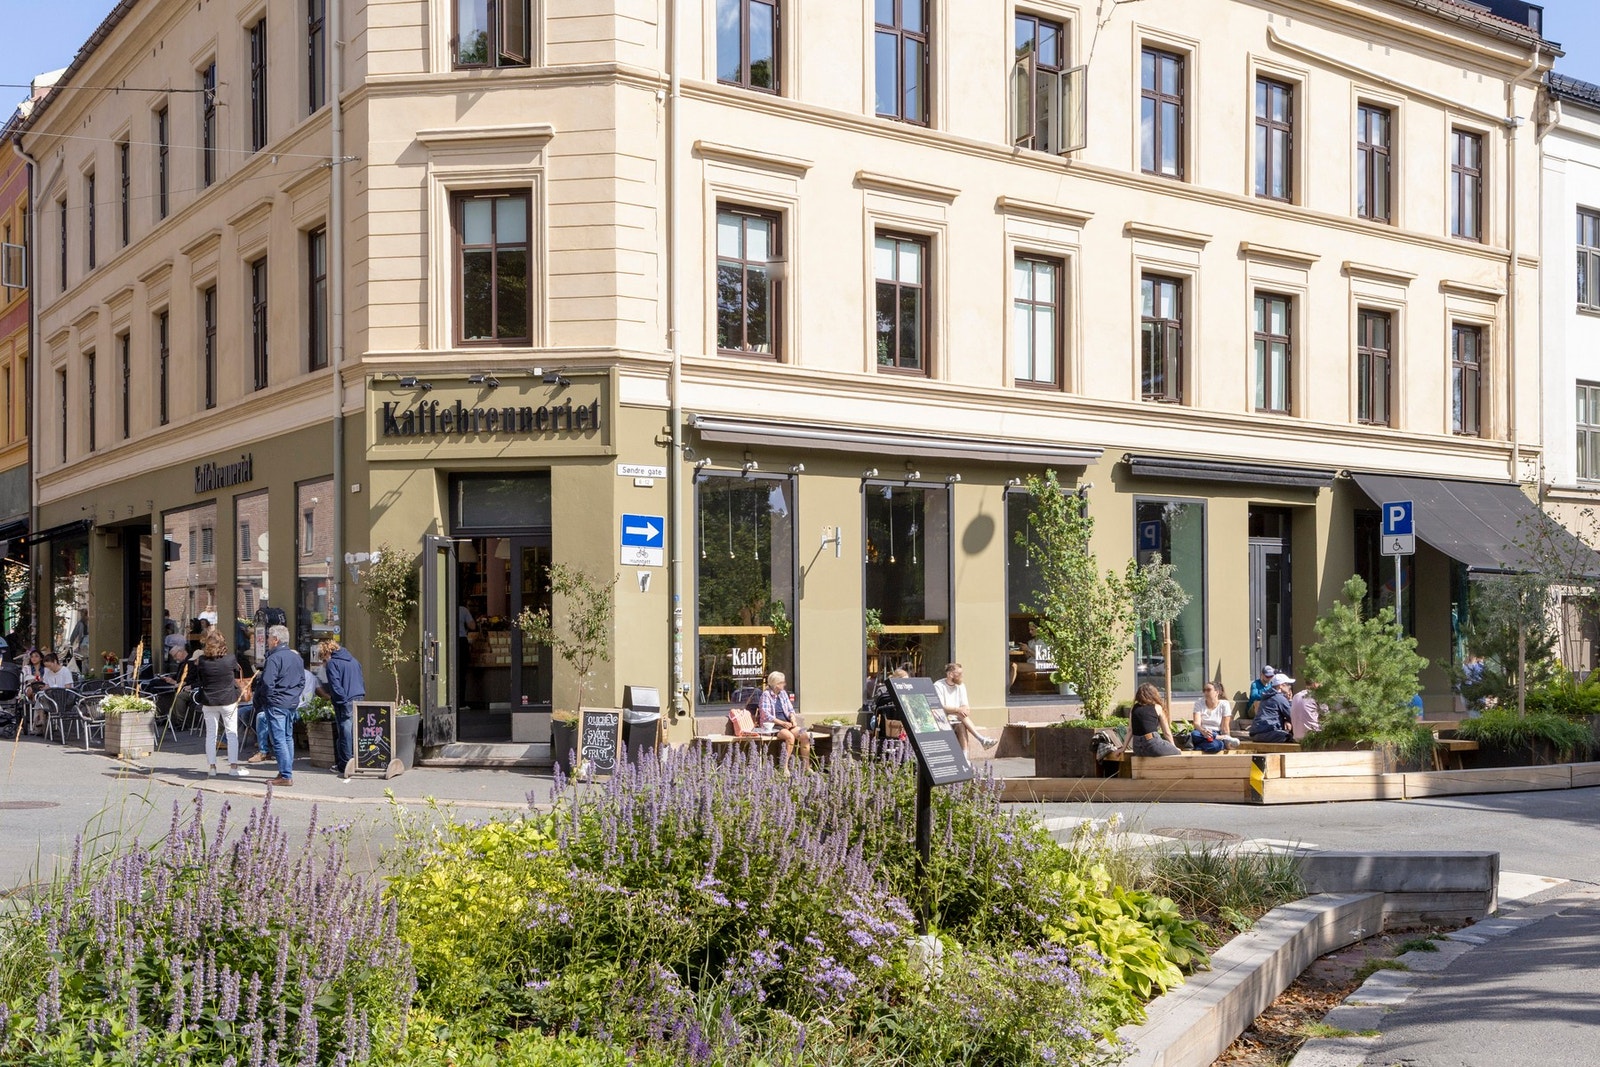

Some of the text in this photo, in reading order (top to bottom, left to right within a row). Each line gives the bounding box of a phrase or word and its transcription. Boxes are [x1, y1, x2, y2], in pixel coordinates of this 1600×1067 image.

[382, 397, 601, 436] Kaffebrenneriet
[194, 453, 253, 493] Kaffebrenneriet
[622, 466, 662, 477] Søndre gate
[1390, 506, 1406, 531] P
[732, 648, 763, 665] Kaffe
[732, 666, 763, 676] brenneriet
[367, 713, 377, 727] IS
[587, 735, 610, 747] KAFFE
[588, 729, 611, 739] SVART
